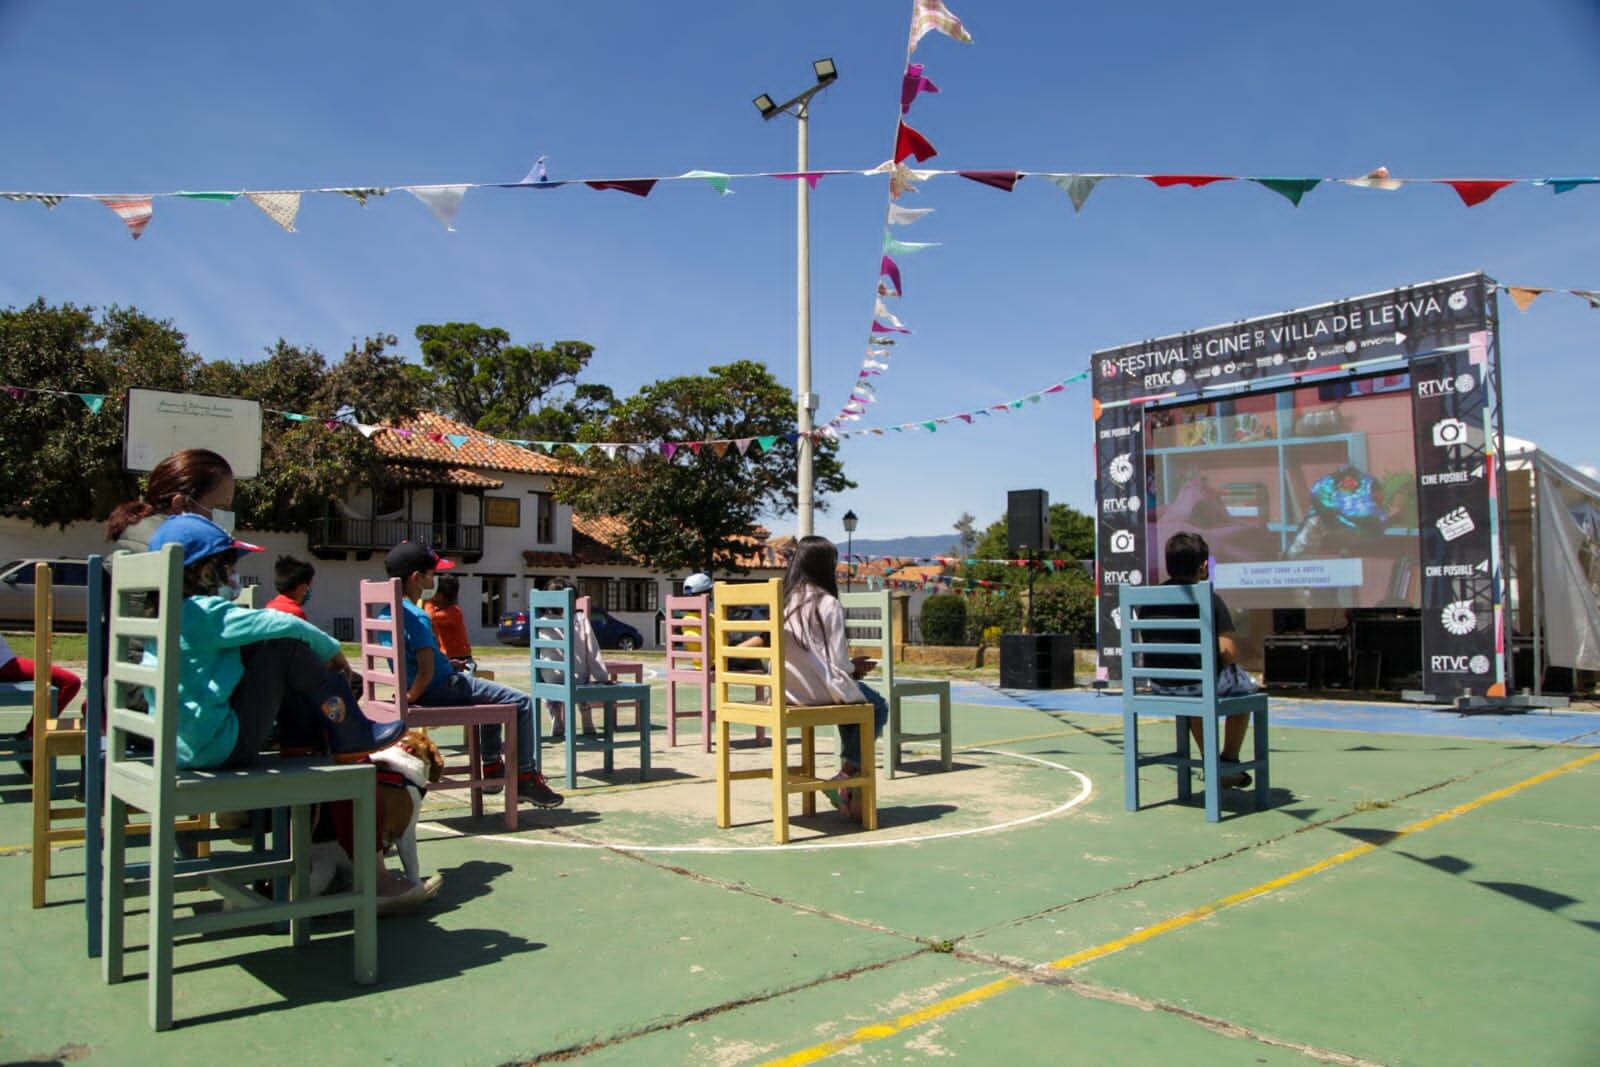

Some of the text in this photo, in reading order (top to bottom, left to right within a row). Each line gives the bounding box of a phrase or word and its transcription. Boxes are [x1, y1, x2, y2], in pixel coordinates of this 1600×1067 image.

[1119, 347, 1188, 372] FESTIVAL
[1192, 343, 1202, 359] DE
[1205, 332, 1250, 357] CINE
[1254, 330, 1265, 347] DE
[1270, 319, 1329, 344] VILLA
[1333, 311, 1363, 333] DE
[1370, 296, 1441, 326] LEYVA
[1144, 371, 1171, 388] RTVC
[1418, 376, 1455, 395] RTVC
[1421, 470, 1468, 485] CINE POSIBLE
[1103, 497, 1127, 510] RTVC
[1104, 571, 1129, 584] RTVC
[1425, 564, 1474, 577] CINE POSIBLE
[1431, 655, 1468, 670] RTVC
